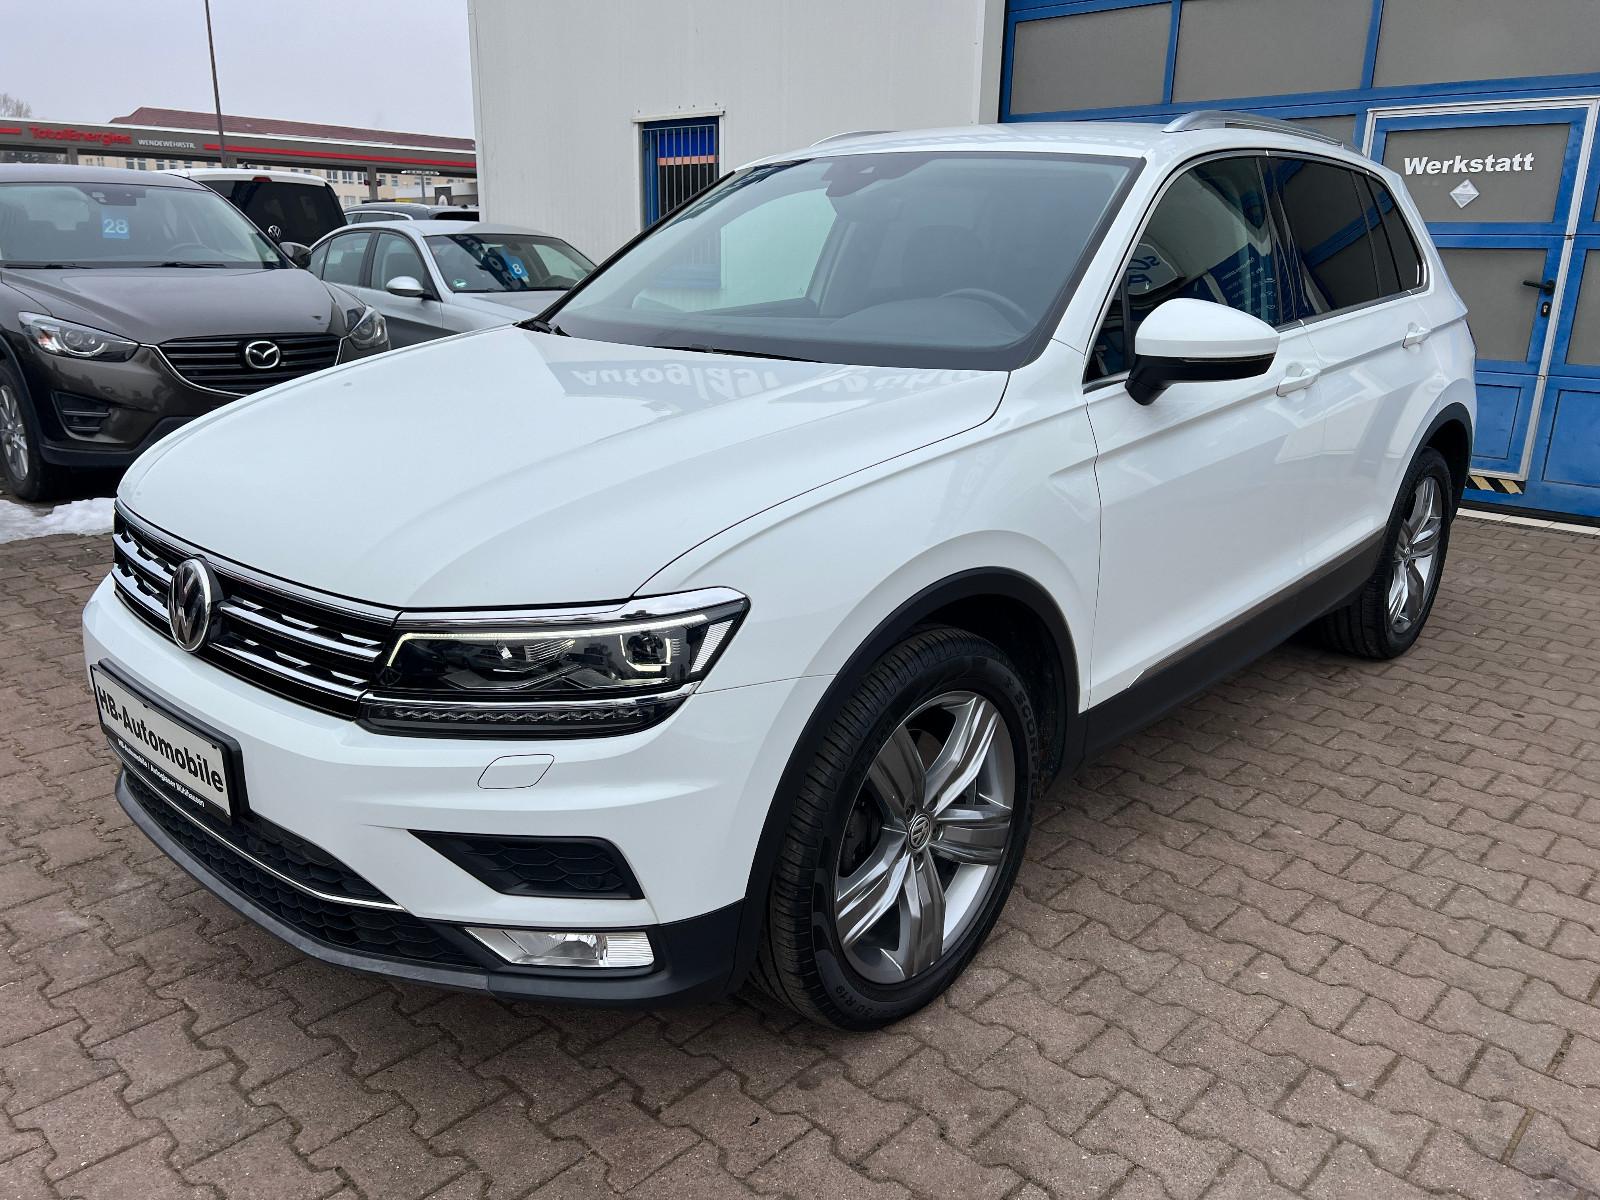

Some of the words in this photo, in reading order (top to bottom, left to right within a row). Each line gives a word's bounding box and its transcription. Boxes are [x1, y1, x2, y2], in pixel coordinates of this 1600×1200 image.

[28, 125, 132, 145] TotalEnergies
[1404, 152, 1535, 175] Werkstatt
[104, 219, 128, 233] 28
[512, 263, 522, 275] 8
[97, 684, 224, 793] HB-Automobile
